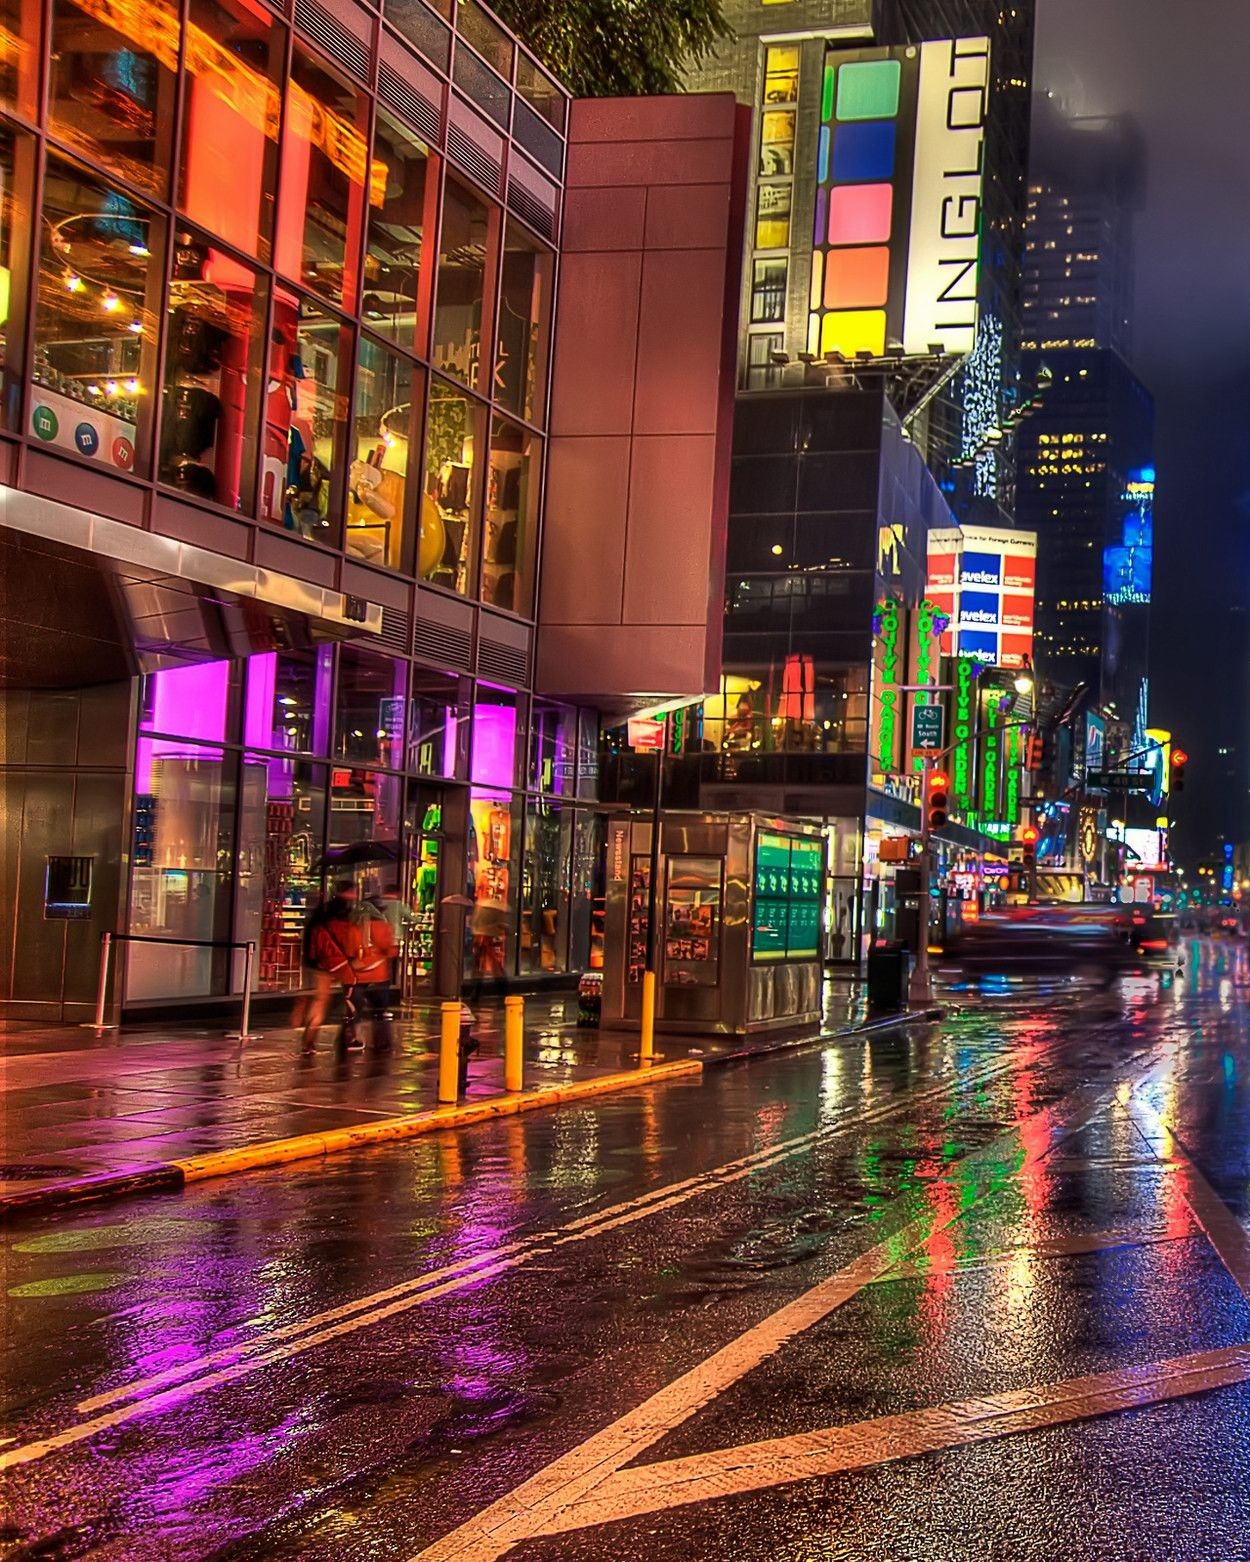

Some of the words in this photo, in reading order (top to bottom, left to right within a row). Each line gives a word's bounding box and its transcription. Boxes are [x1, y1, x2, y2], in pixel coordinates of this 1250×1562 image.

[933, 36, 989, 331] INGLOT
[882, 616, 899, 684] OLIVE
[957, 661, 972, 721] OLIVE
[878, 690, 897, 772] GARDEN
[612, 830, 625, 882] Newsstand
